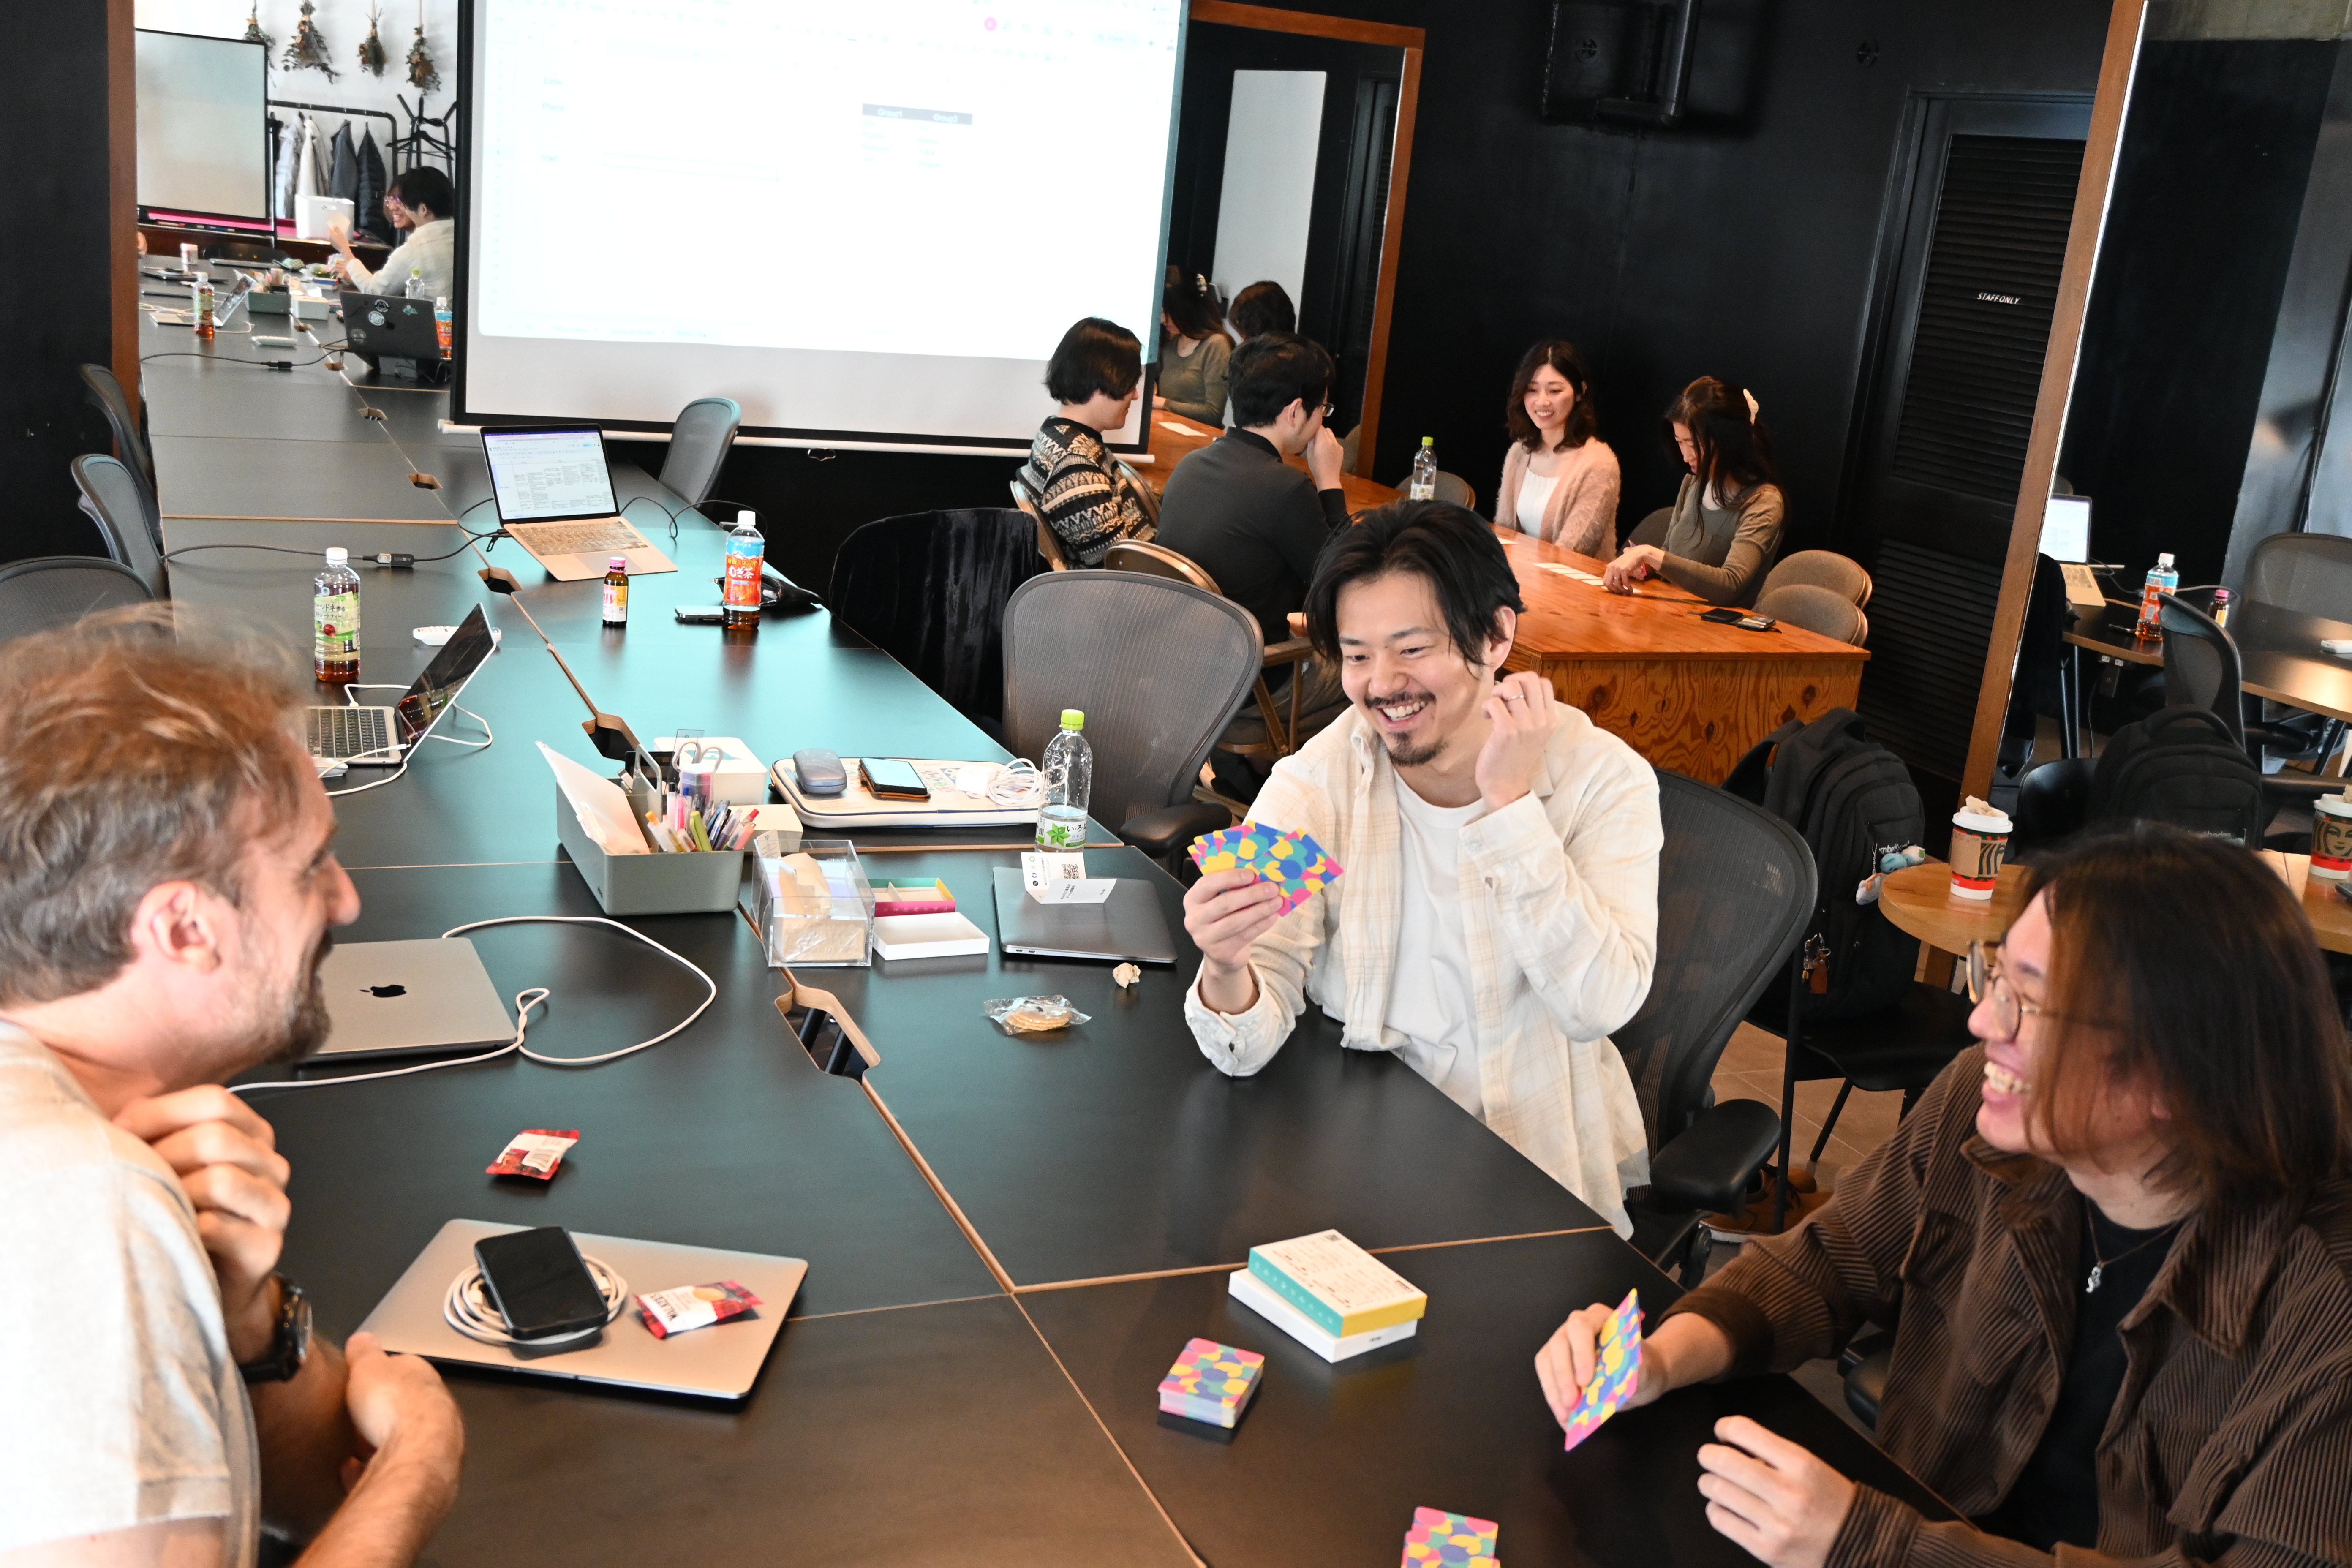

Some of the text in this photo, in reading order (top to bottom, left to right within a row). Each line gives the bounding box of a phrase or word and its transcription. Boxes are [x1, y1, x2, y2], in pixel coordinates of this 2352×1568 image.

[543, 76, 563, 86] Date
[542, 102, 565, 112] Place
[878, 108, 958, 123] Group1 Group2
[540, 153, 559, 163] Start
[1977, 292, 2020, 305] STAFF ONLY
[728, 565, 754, 579] むぎ茶
